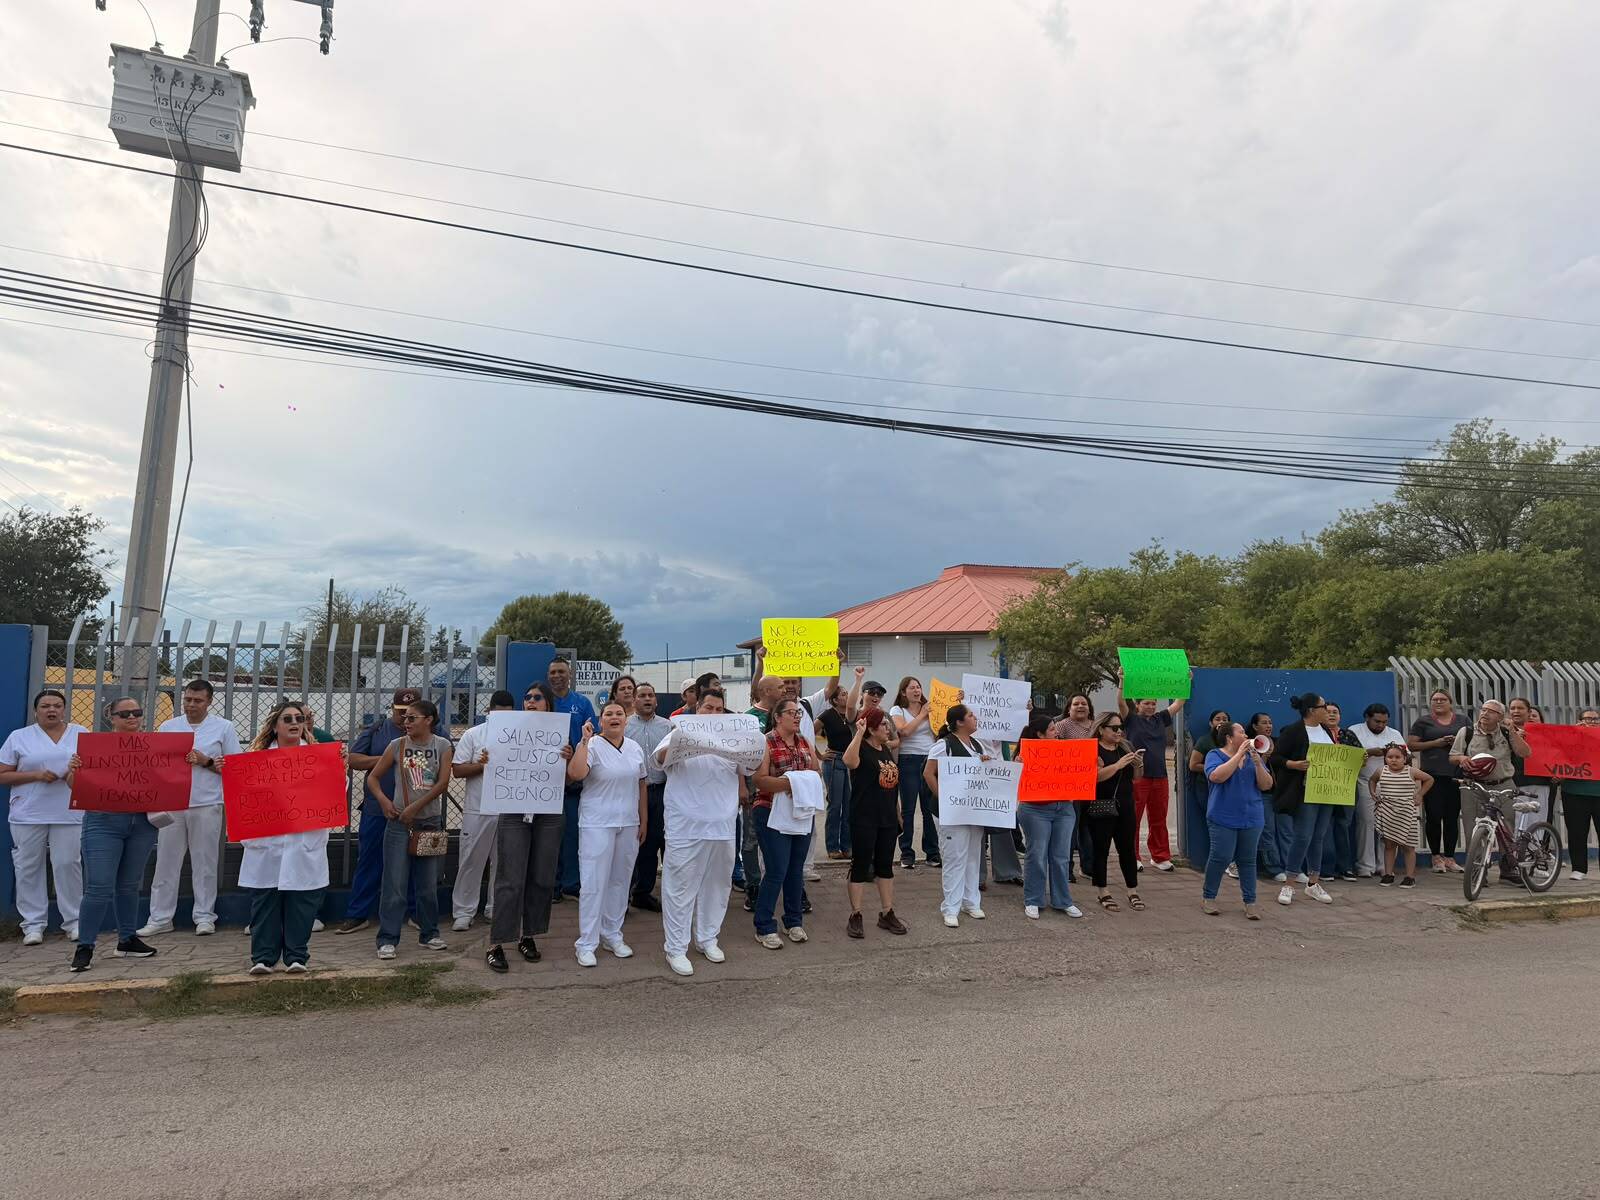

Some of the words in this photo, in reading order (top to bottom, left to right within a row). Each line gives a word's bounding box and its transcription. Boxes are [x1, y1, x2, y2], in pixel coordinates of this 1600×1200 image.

[770, 625, 787, 638] NO
[576, 671, 620, 680] REATIVO
[982, 681, 1001, 695] MAS
[968, 694, 1012, 708] INSUMOS
[979, 708, 1000, 719] PARA
[119, 735, 150, 750] MAS
[498, 727, 562, 747] SALARIO
[507, 748, 560, 765] JUSTO
[495, 765, 550, 783] RETIRO
[947, 761, 960, 775] La
[985, 766, 1011, 777] unida
[1543, 762, 1593, 778] VIDAS
[117, 769, 149, 785] MAS
